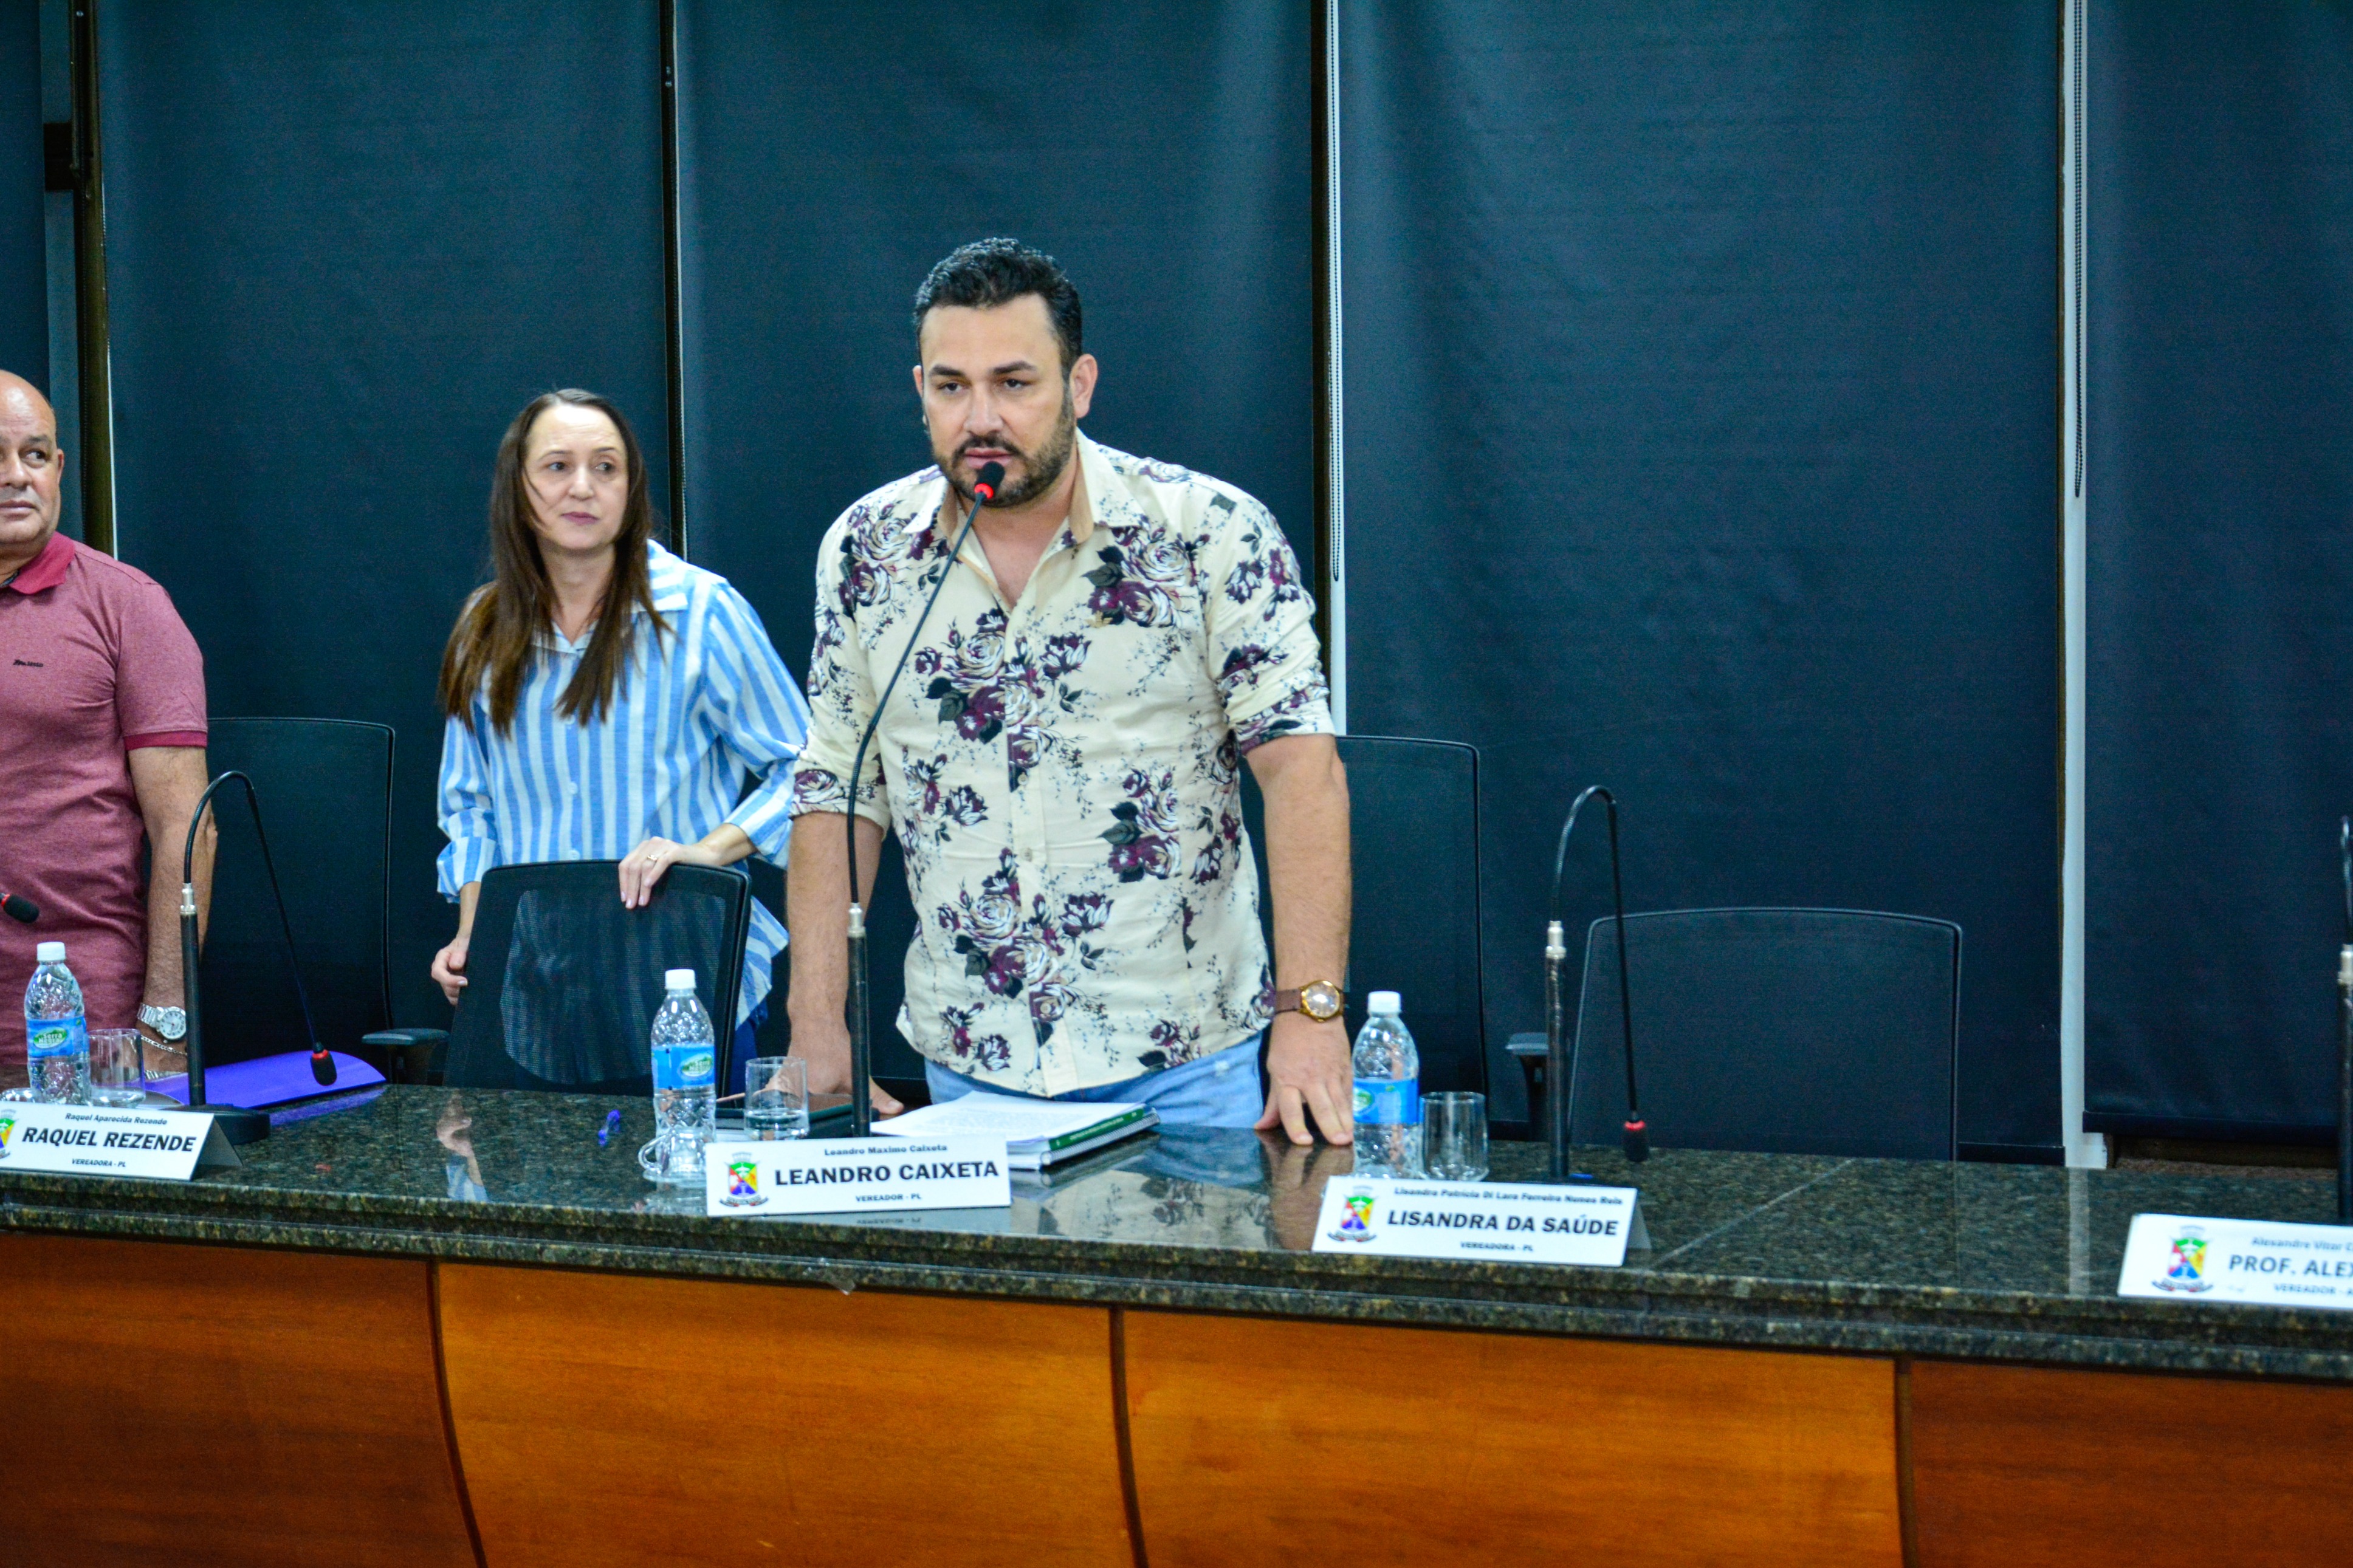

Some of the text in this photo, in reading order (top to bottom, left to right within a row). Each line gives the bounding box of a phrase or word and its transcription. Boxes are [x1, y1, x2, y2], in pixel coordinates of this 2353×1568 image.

[22, 1127, 196, 1152] RAQUEL REZENDE
[72, 1158, 112, 1166] VEREADORA
[775, 1161, 998, 1185] LEANDRO CAIXETA
[1388, 1210, 1619, 1236] LISANDRA DA SAÚDE
[1460, 1241, 1516, 1250] VEREADORA
[2229, 1255, 2353, 1277] PROF. ALE
[2274, 1284, 2335, 1294] VEREADOR
